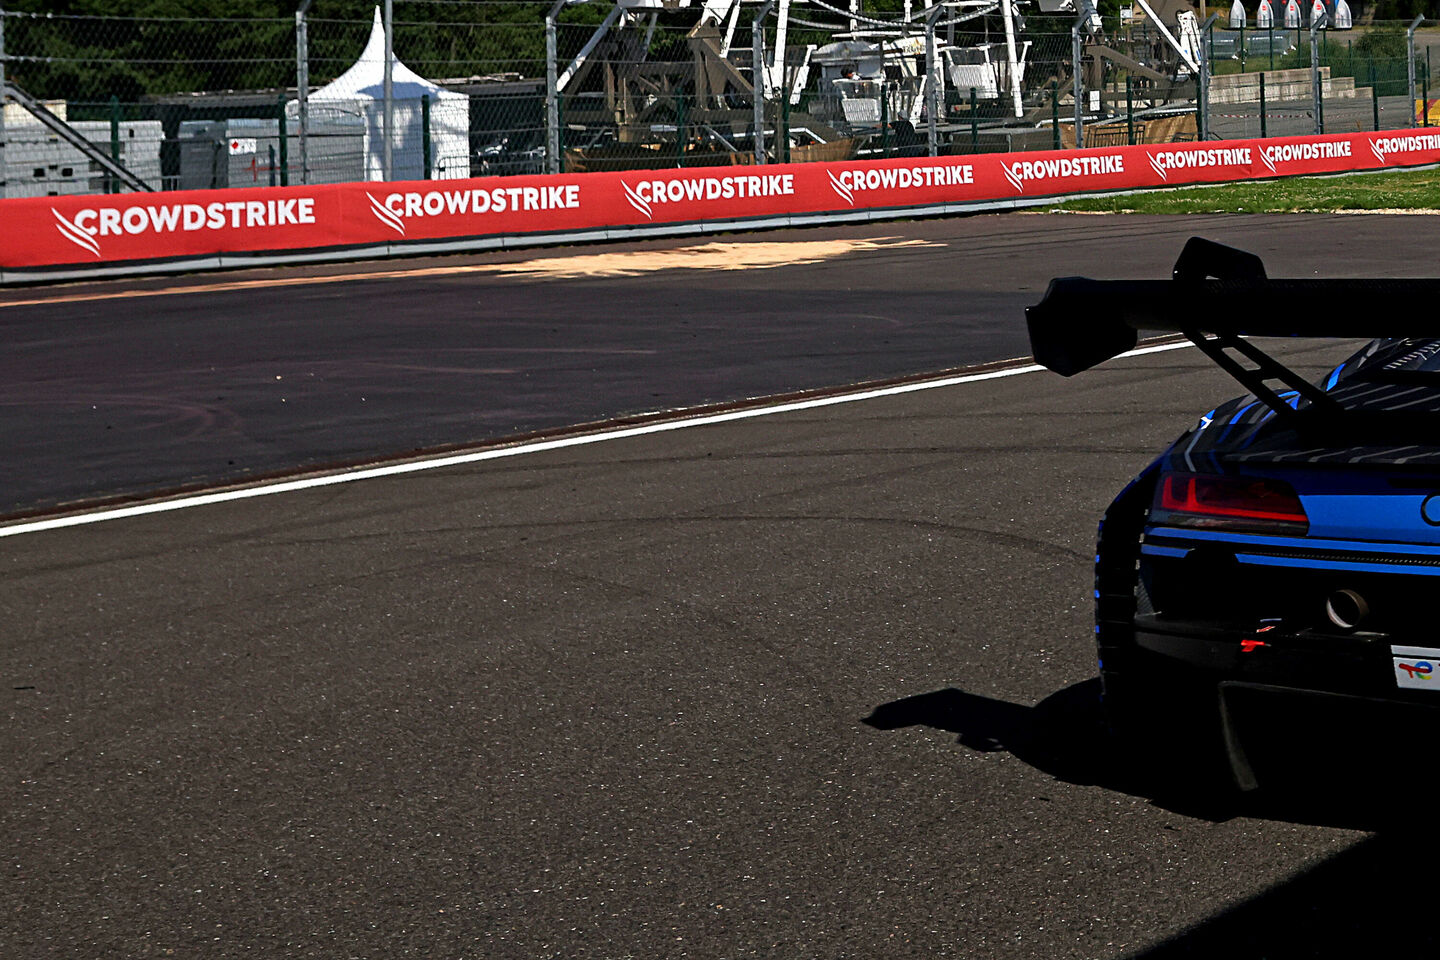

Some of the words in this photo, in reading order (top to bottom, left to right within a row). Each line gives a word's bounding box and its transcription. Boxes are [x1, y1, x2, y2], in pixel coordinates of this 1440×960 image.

[1156, 148, 1252, 169] CROWDSTRIKE
[1266, 141, 1352, 163] CROWDSTRIKE
[840, 165, 974, 191] CROWDSTRIKE
[1012, 155, 1125, 181] CROWDSTRIKE
[385, 185, 580, 218] CROWDSTRIKE
[636, 174, 795, 204] CROWDSTRIKE
[74, 198, 316, 236] CROWDSTRIKE
